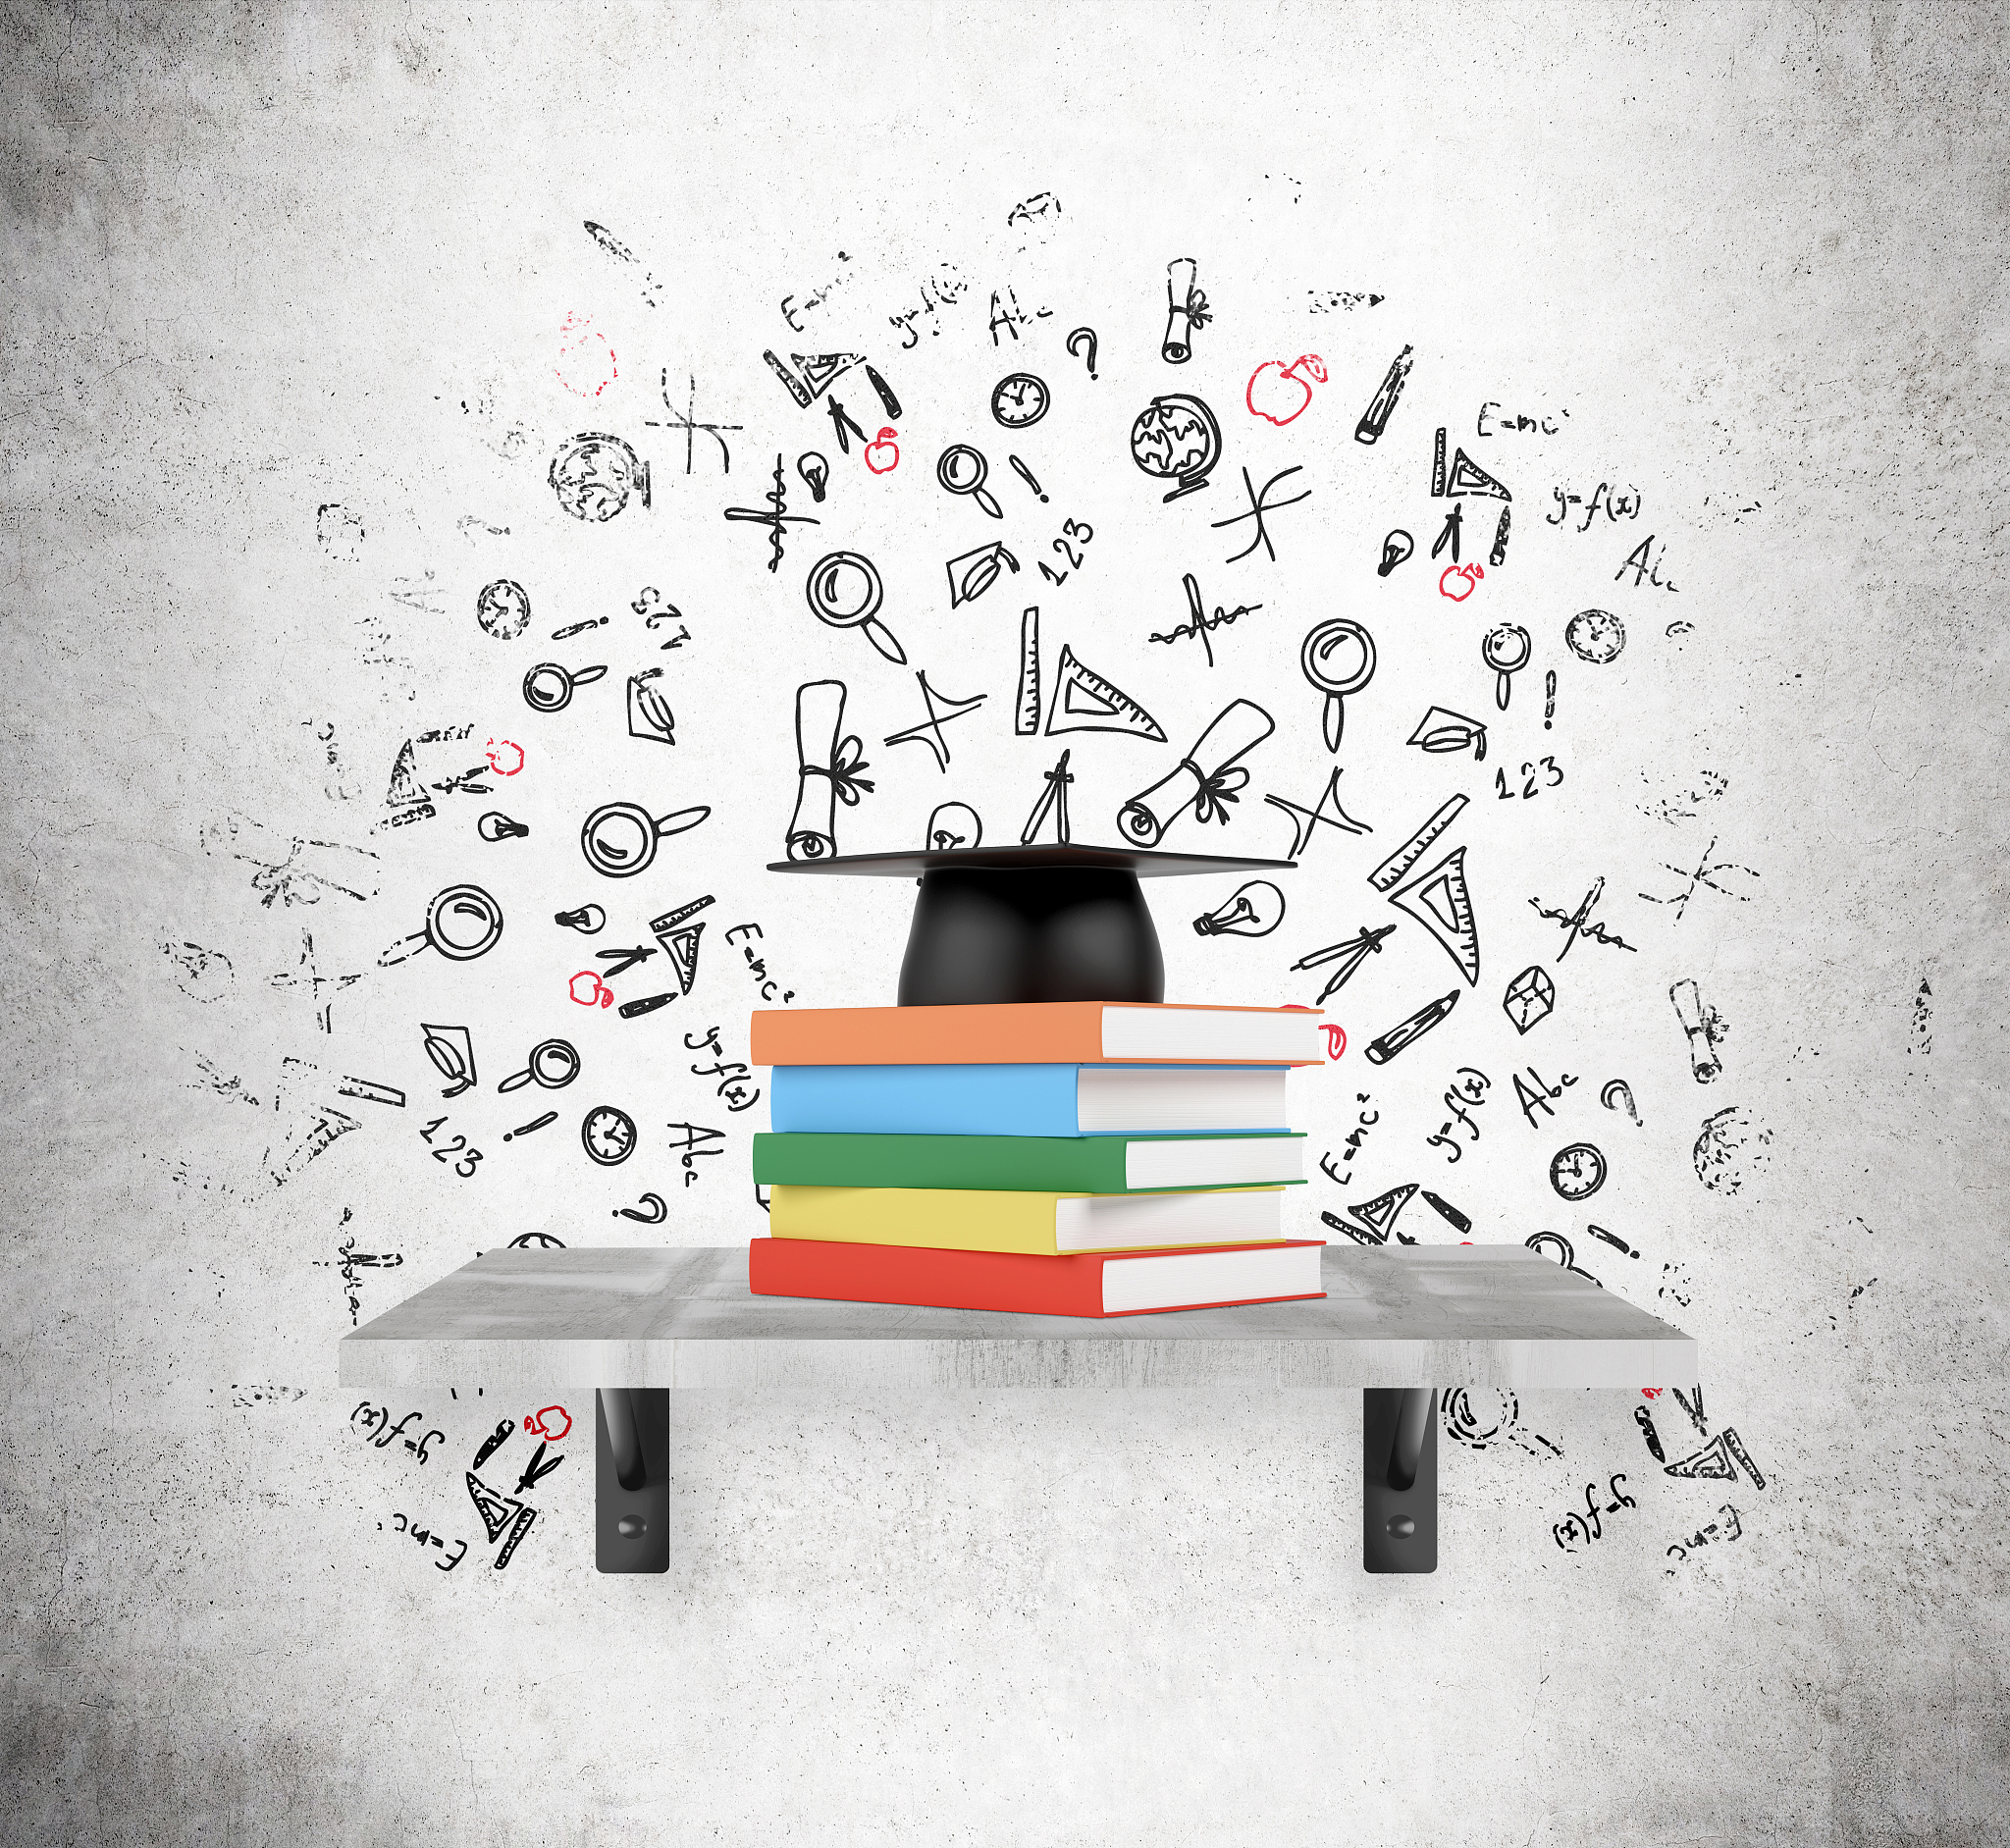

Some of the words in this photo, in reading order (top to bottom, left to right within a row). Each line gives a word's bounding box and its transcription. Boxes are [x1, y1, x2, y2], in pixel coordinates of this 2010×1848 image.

[1495, 755, 1564, 800] 123
[724, 923, 796, 1004] E=mc²
[1512, 1066, 1579, 1130] Abc
[419, 1116, 484, 1179] 123
[1318, 1092, 1380, 1186] E=mc²
